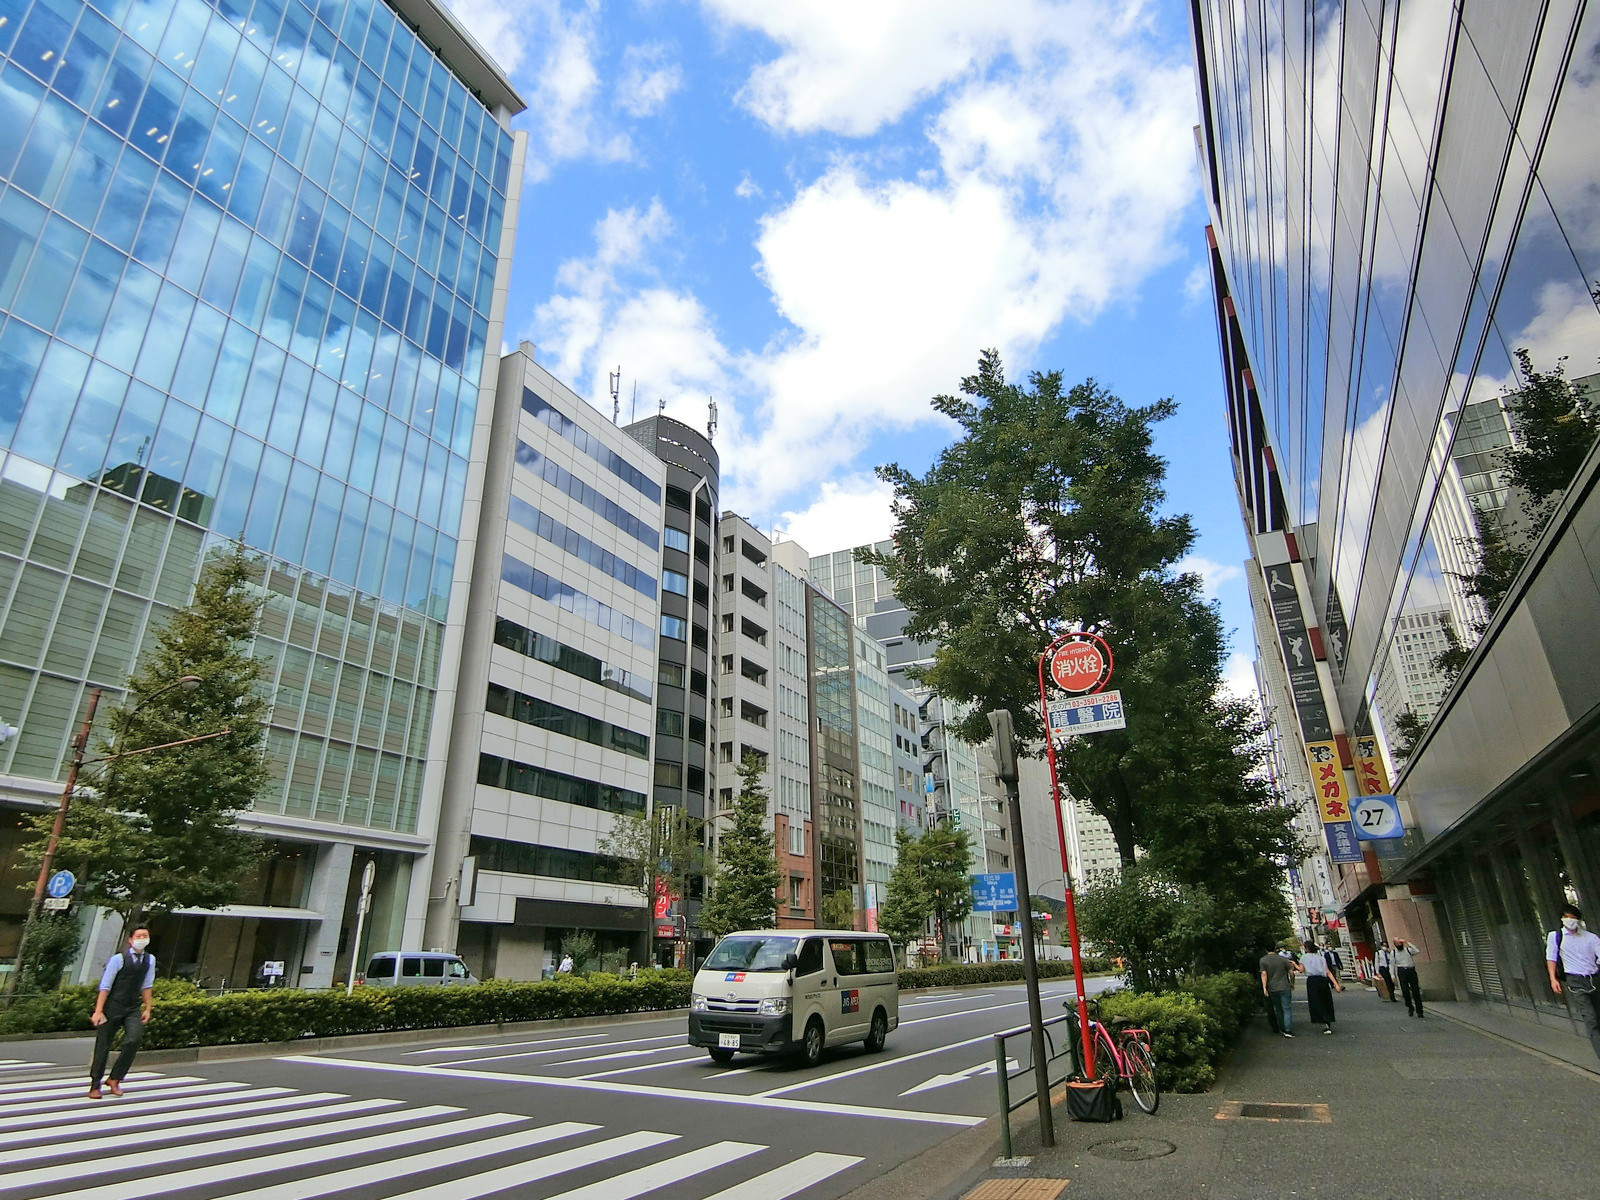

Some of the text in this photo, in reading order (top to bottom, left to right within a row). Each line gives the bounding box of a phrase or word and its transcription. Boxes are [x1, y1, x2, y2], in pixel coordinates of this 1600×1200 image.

[1070, 646, 1091, 655] HYDRANT
[1056, 654, 1099, 679] 消火栓
[1051, 694, 1118, 711] 虎の門 03-3501-2286
[1319, 763, 1346, 818] メガネ
[1359, 808, 1384, 827] 27
[53, 876, 65, 893] P
